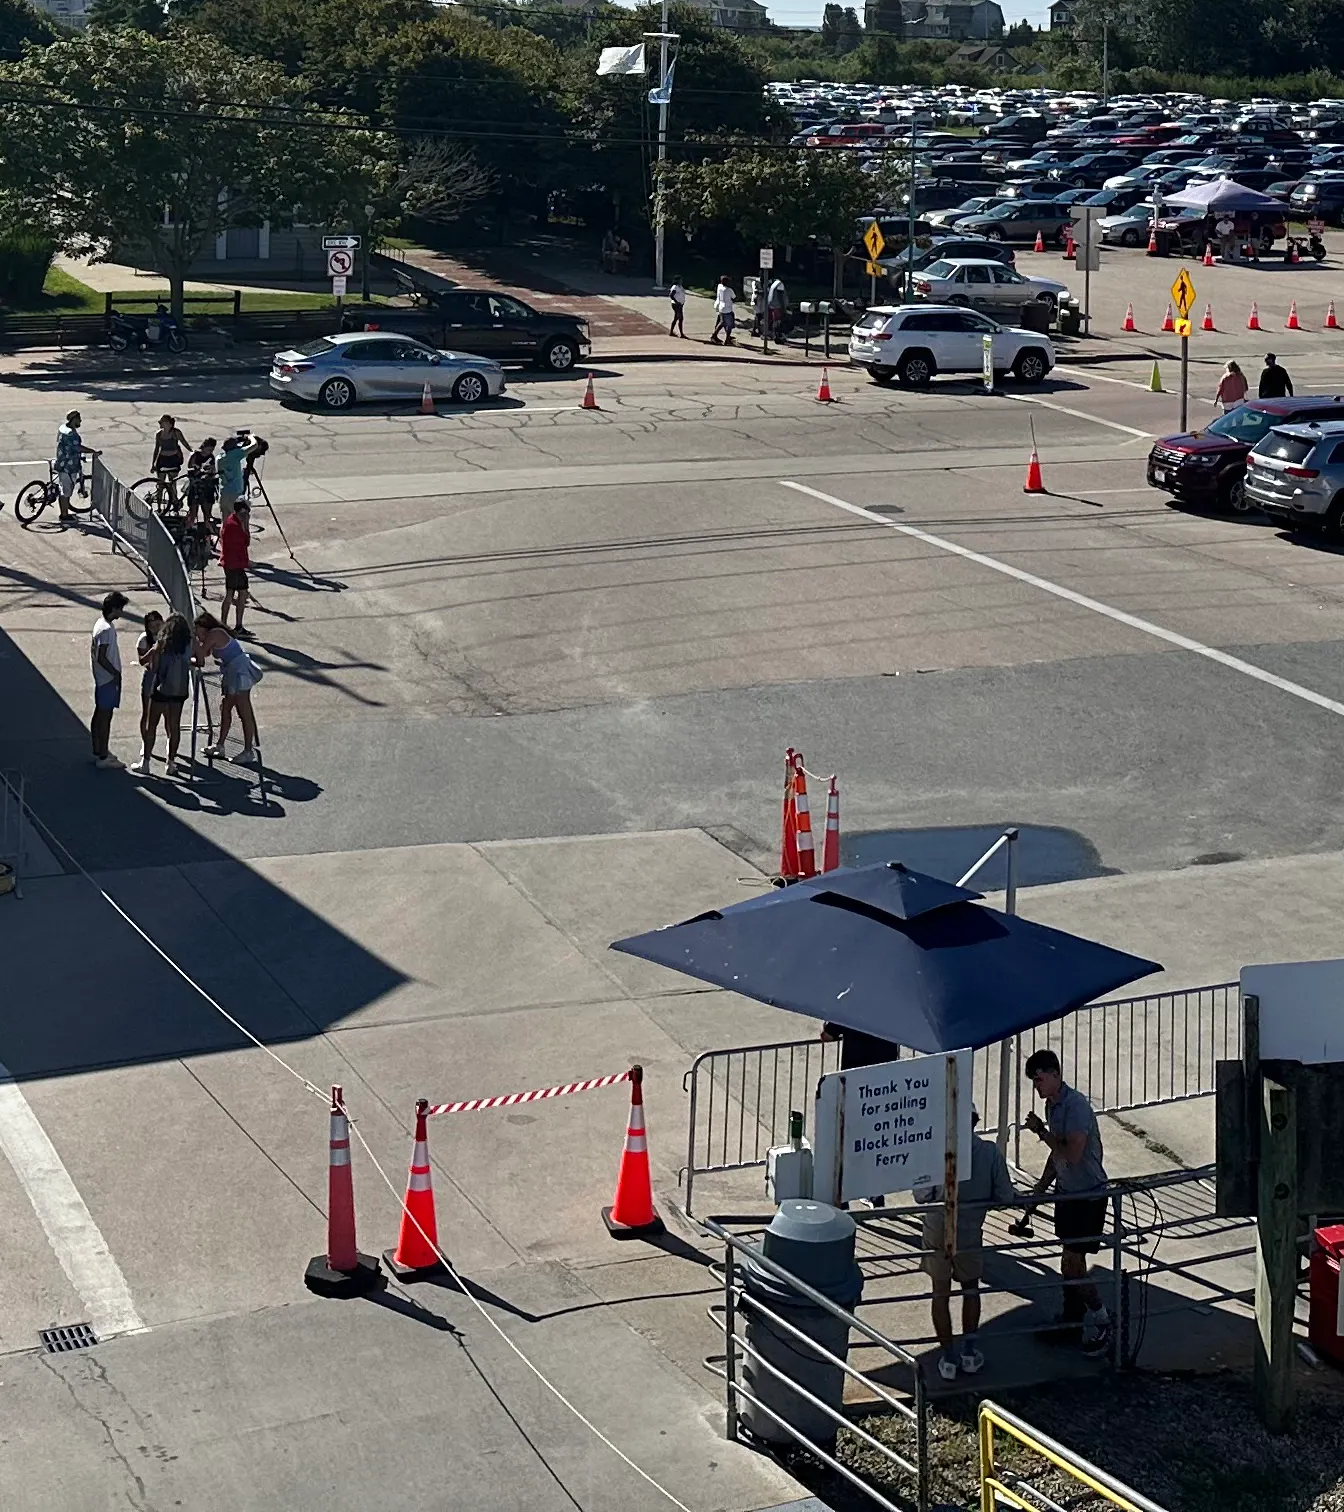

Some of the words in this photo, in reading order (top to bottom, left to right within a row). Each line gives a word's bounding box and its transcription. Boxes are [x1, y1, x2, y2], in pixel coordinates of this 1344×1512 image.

[858, 1080, 898, 1099] Thank
[904, 1076, 930, 1091] You
[861, 1102, 881, 1117] for
[884, 1095, 927, 1113] sailing
[873, 1121, 890, 1132] on
[894, 1114, 915, 1129] the
[854, 1134, 889, 1153] Block
[893, 1126, 933, 1146] Island
[875, 1151, 910, 1168] Ferry
